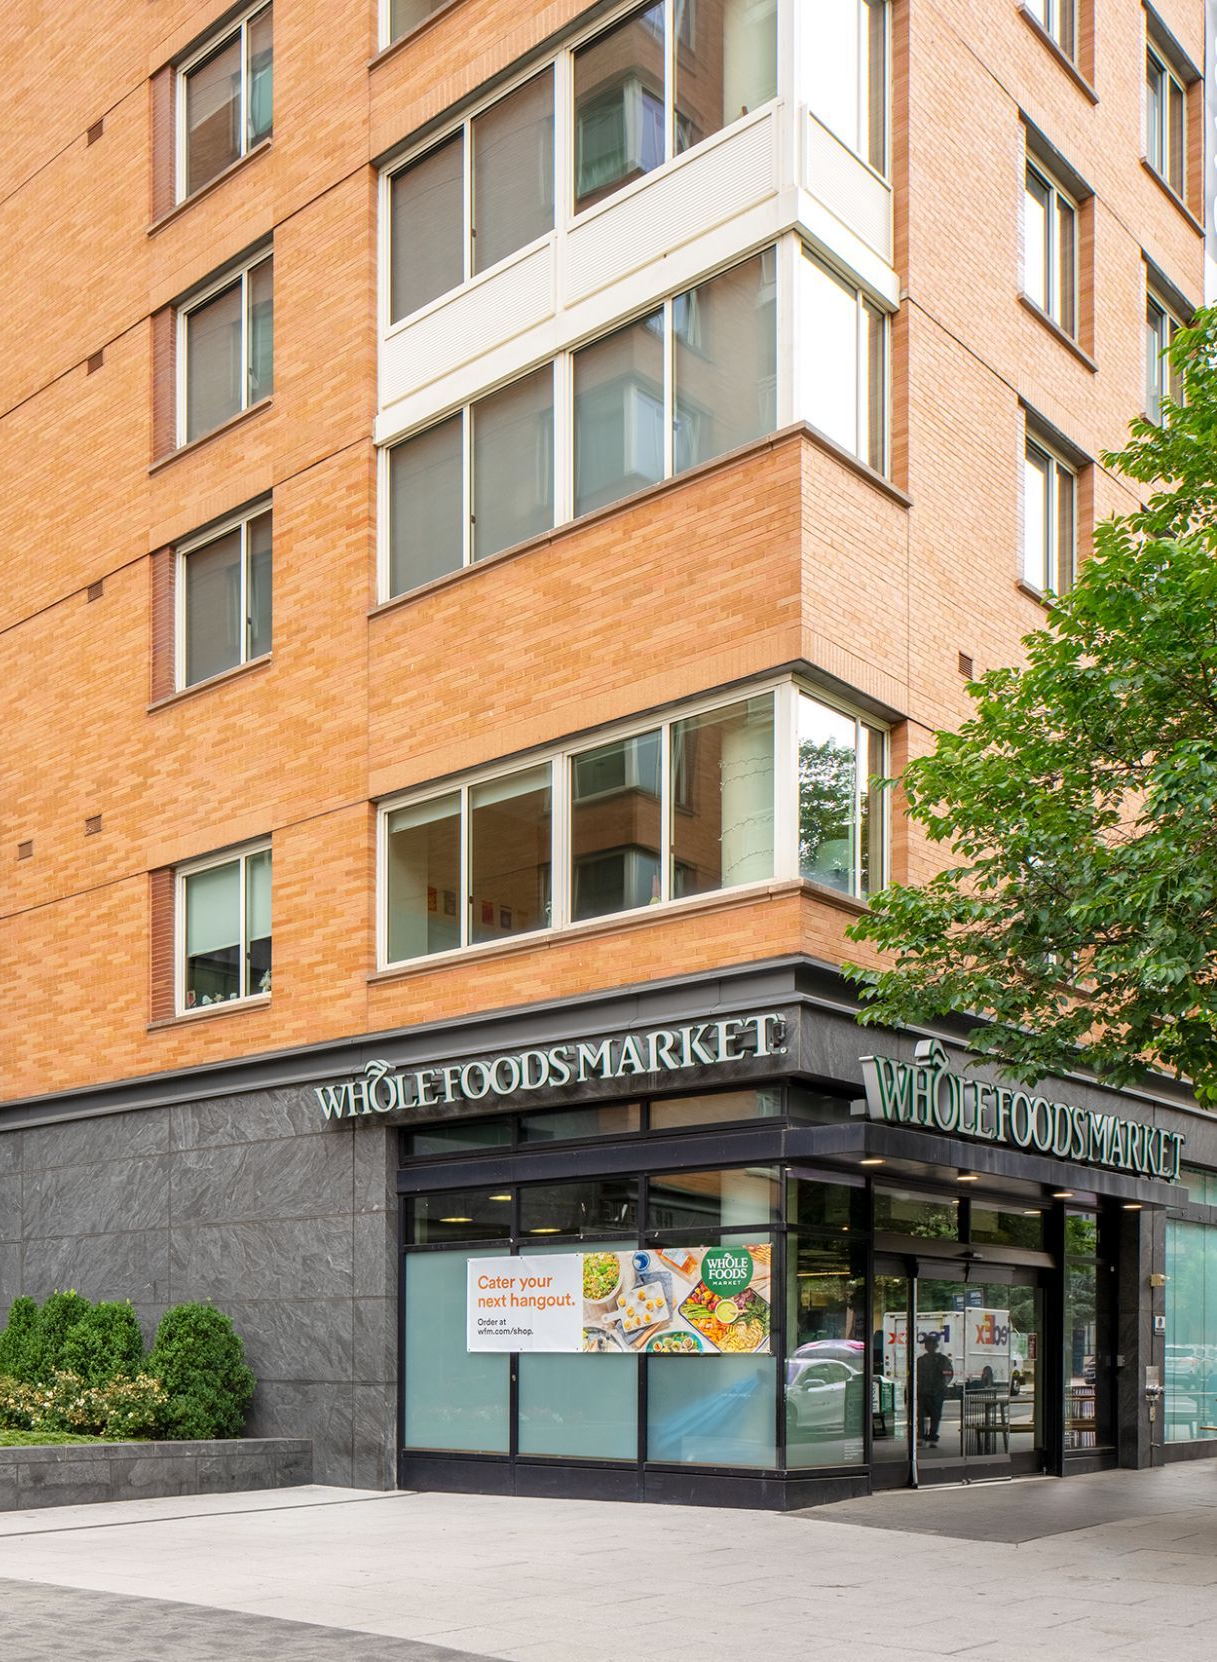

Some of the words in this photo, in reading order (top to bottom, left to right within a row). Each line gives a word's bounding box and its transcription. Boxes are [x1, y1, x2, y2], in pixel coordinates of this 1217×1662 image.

[314, 1059, 439, 1120] WHOLE
[442, 1046, 573, 1104] FOODS
[868, 1038, 996, 1141] WHOLE
[991, 1084, 1085, 1161] FOODS
[1085, 1110, 1186, 1181] MARKET
[707, 1253, 749, 1269] WHOLE
[708, 1268, 748, 1280] FOODS
[477, 1275, 516, 1290] Cater
[518, 1277, 553, 1292] your
[477, 1295, 507, 1308] next
[510, 1293, 576, 1311] hangout.
[477, 1318, 498, 1327] Order
[498, 1318, 507, 1326] at
[477, 1327, 534, 1336] wfm.com/shop.
